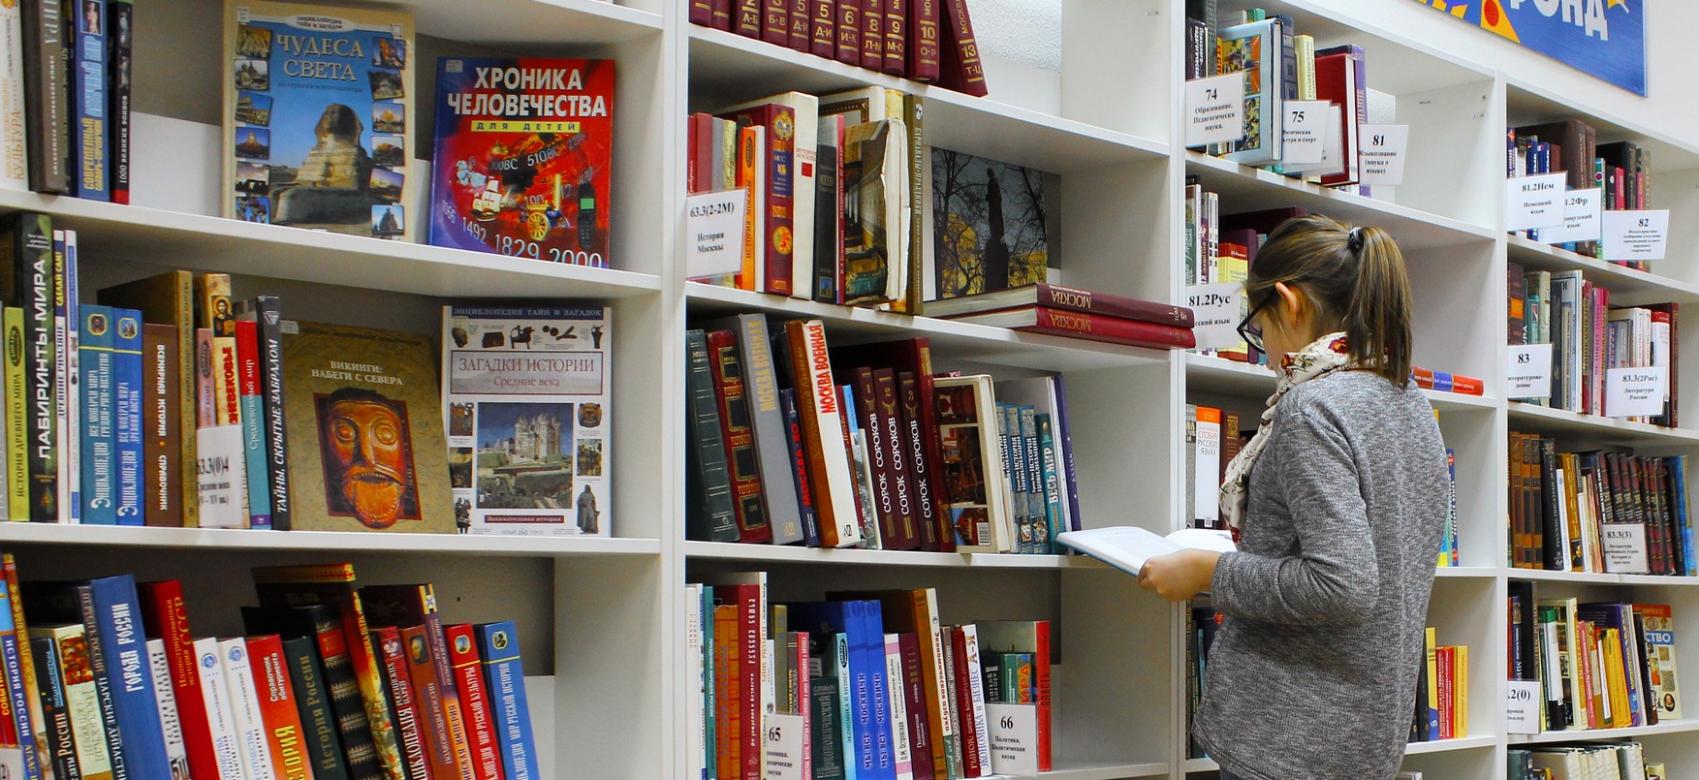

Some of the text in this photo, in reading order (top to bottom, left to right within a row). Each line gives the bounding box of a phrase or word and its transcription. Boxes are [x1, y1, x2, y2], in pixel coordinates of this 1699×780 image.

[742, 13, 759, 24] А-Б
[768, 14, 786, 26] Б-В
[819, 5, 829, 17] 5
[845, 11, 854, 24] 6
[815, 26, 832, 38] Д-И
[869, 19, 878, 31] 8
[891, 19, 900, 34] 9
[921, 26, 935, 38] 10
[276, 34, 365, 58] ЧУДЕСА
[840, 31, 857, 43] И-К
[864, 40, 882, 52] Л-М
[887, 40, 904, 51] М-О
[920, 46, 936, 56] О-Р
[961, 44, 977, 57] 13
[284, 59, 357, 81] СВЕТА
[474, 67, 583, 90] ХРОНИКА
[965, 66, 983, 76] Т-Ц
[1205, 87, 1218, 101] 74
[447, 93, 608, 118] ЧЕЛОВЕЧЕСТВА
[475, 121, 576, 132] ДЛЯ ДЕТЕЙ
[1292, 111, 1305, 123] 75
[10, 110, 25, 180] КУЛЬТУРА
[120, 128, 128, 163] великих
[1372, 134, 1385, 146] 81
[80, 117, 94, 190] СОВРЕМЕННЫЙ
[119, 165, 127, 184] 1000
[1521, 182, 1555, 192] 81.2Нем
[1564, 198, 1588, 206] 1.2Фр
[462, 216, 487, 244] 1492
[1638, 218, 1649, 227] 82
[494, 233, 540, 260] 1829
[1051, 290, 1091, 309] МОСКВА
[1188, 293, 1231, 309] 81.2Рус
[1051, 314, 1091, 332] МОСКВА
[33, 259, 52, 460] ЛАБИРИНТЫ МИРА
[245, 359, 255, 378] мир
[458, 358, 595, 372] ЗАГАДКИ ИСТОРИИ
[747, 321, 777, 412] МОСКВА ВОЕННАЯ
[809, 325, 837, 414] МОСКВА ВОЕННАЯ
[1517, 353, 1530, 364] 83
[268, 339, 281, 405] ЗАБРАЛОМ
[311, 368, 403, 386] НАБЕГИ С СЕВЕРА
[493, 376, 561, 387] Средние века
[12, 373, 22, 399] МИРА
[13, 401, 24, 451] ДРЕВНЕГО
[156, 344, 168, 511] ВСЕМИРНАЯ ИСТОРИЯ СПРАВОЧНИК
[271, 406, 285, 465] СКРЫТЫЕ
[869, 412, 892, 514] СОРОК СОРОКОВ
[888, 416, 910, 516] СОРОК СОРОКОВ
[910, 419, 932, 519] СОРОК СОРОКОВ
[15, 452, 25, 497] ИСТОРИЯ
[90, 442, 111, 509] ЭНЦИКЛОПЕДИЯ
[117, 451, 138, 517] ЭНЦИКЛОПЕДИЯ
[1043, 447, 1059, 504] ВЕСЬ МИР
[1607, 530, 1632, 539] 83.3(3)
[111, 602, 144, 693] ГОРОДА РОССИИ
[1645, 632, 1671, 642] СТВО
[965, 634, 977, 664] А-Я
[5, 639, 21, 690] ИСТОРИЯ
[15, 692, 30, 737] РОССИИ
[263, 656, 279, 702] Справочник
[970, 668, 982, 703] БИЗНЕС
[97, 676, 117, 725] ЦАРСКИЕ
[464, 666, 491, 746] МИР РУССКОЙ КУЛЬТУРЫ
[498, 662, 520, 740] МИР РУССКОЙ ИСТОРИИ
[857, 672, 869, 725] МОСКВИЧИ
[873, 672, 884, 723] МОСКВИЧИ
[299, 654, 337, 770] История России
[1000, 715, 1014, 730] 66
[54, 712, 73, 757] России
[447, 703, 464, 746] ИМПЕРИЯ
[768, 726, 781, 742] 65
[975, 714, 990, 768] ЭКОНОМИКА
[864, 751, 873, 769] МЫ
[880, 750, 888, 768] МЫ
